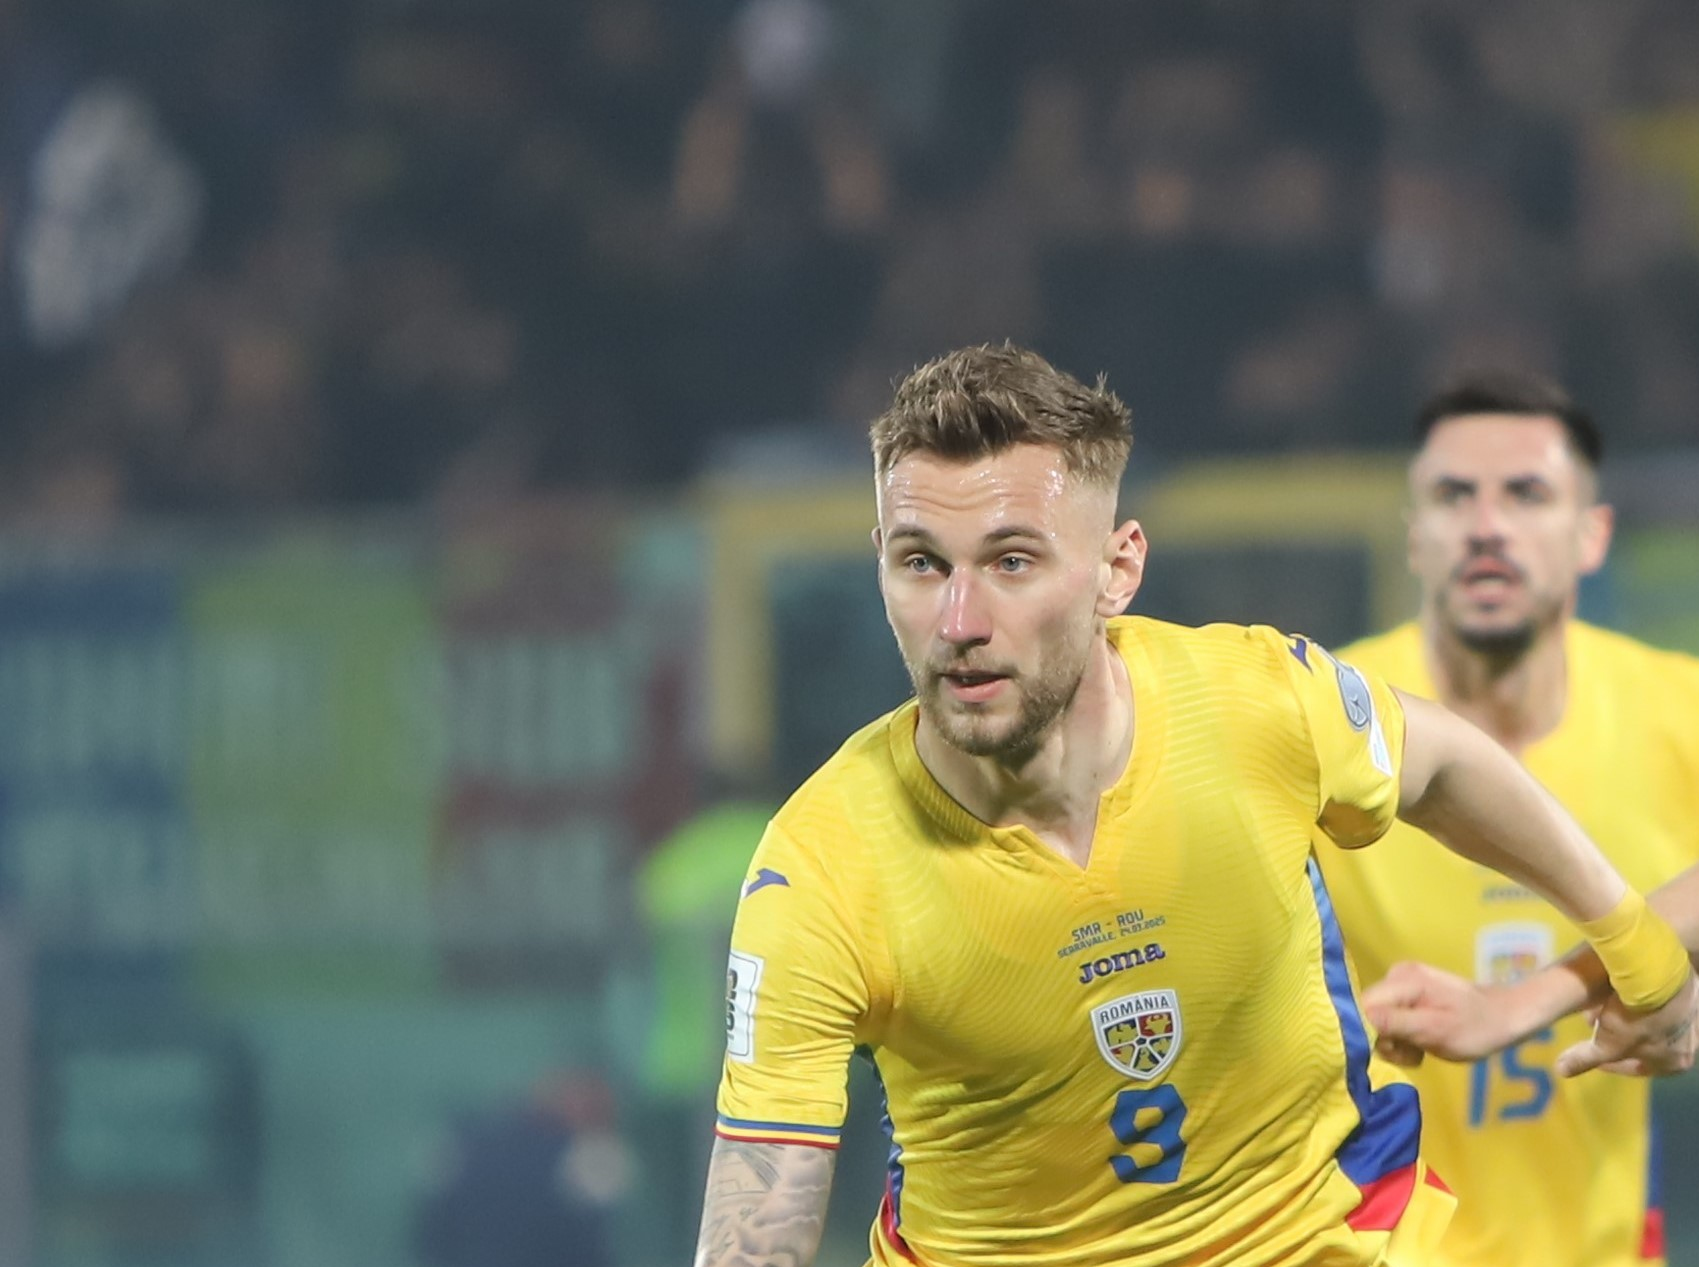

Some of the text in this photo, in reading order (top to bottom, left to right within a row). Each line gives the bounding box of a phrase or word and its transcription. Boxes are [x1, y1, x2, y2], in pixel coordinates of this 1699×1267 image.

[1071, 922, 1102, 942] SMR
[1116, 908, 1145, 927] ROU
[1468, 1025, 1556, 1128] 15
[1107, 1082, 1188, 1184] 9
